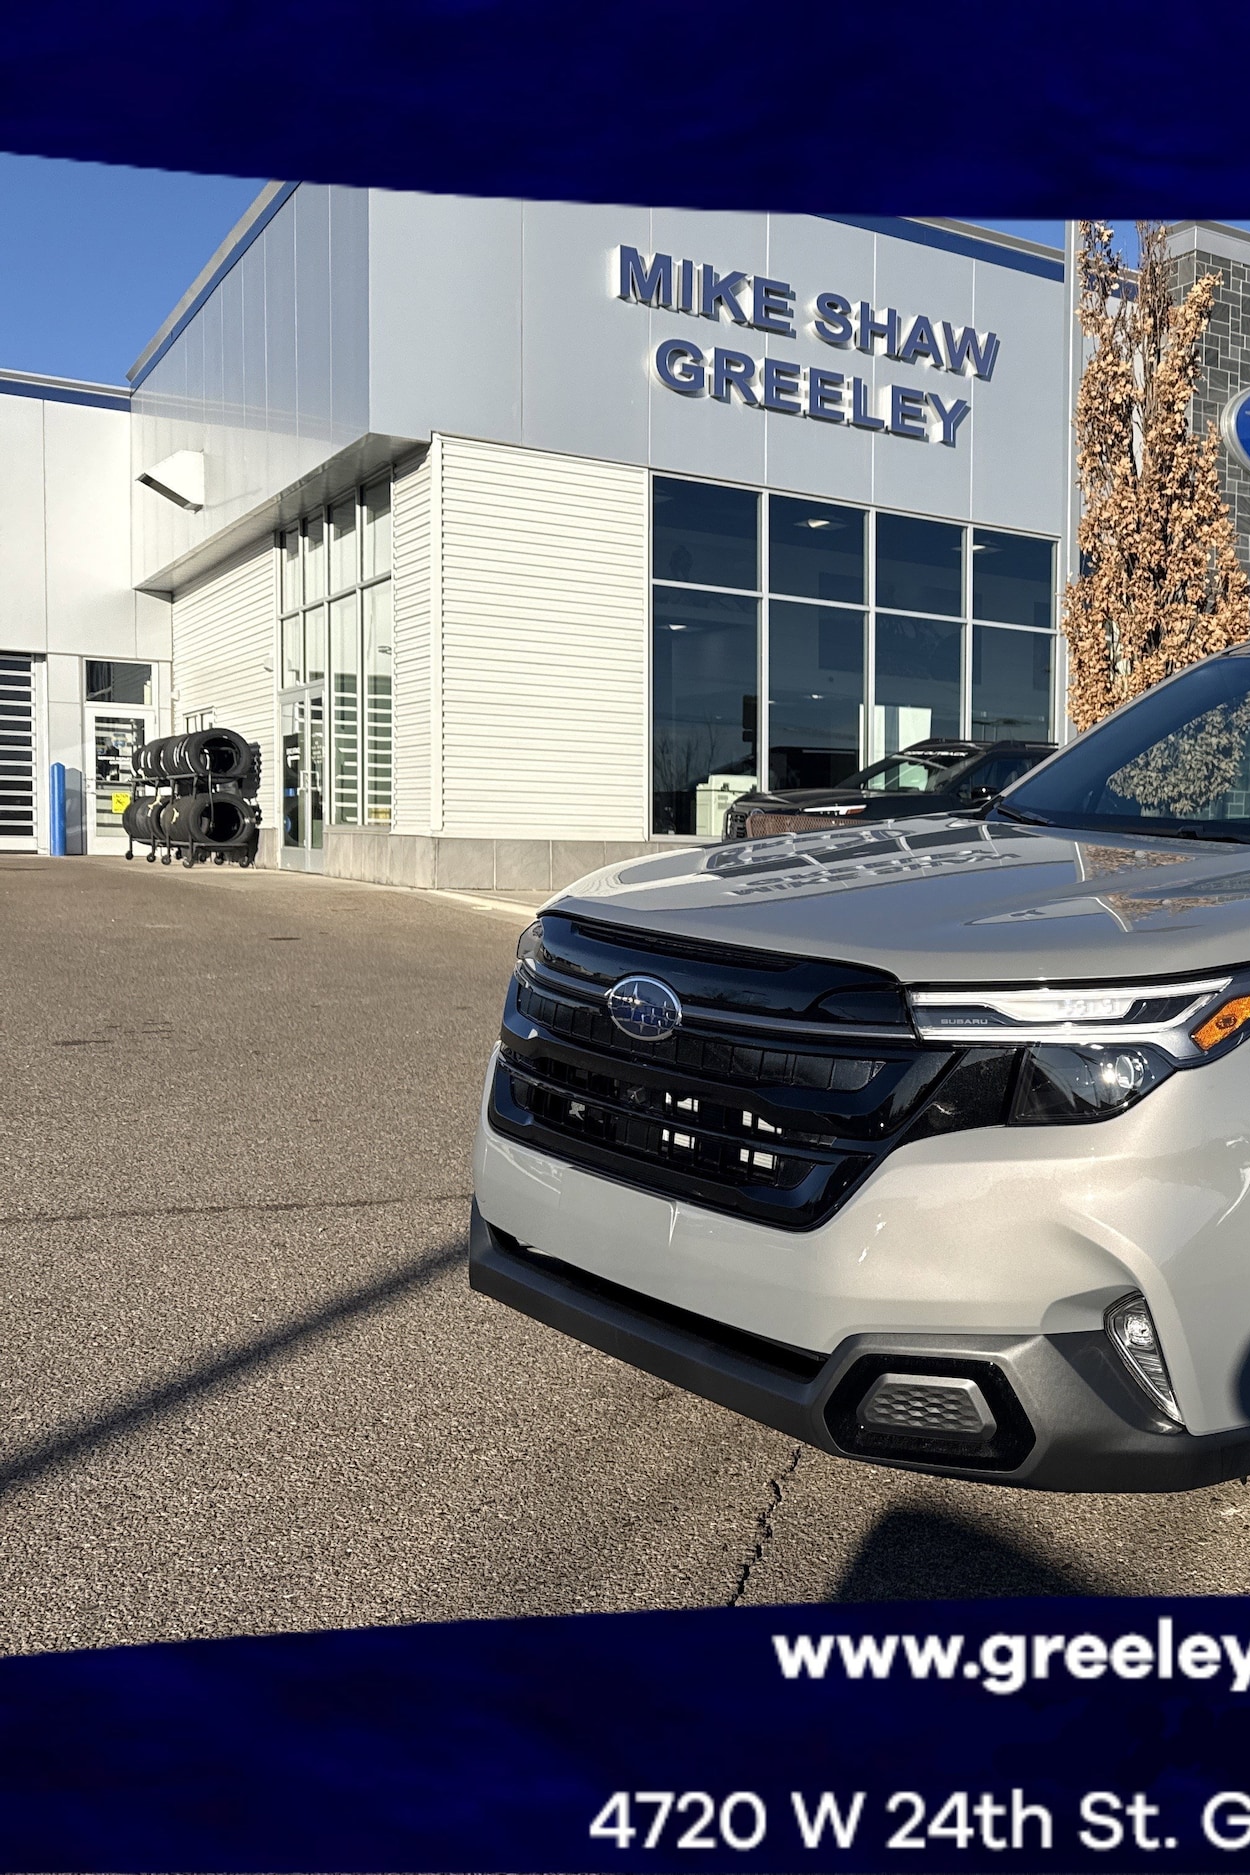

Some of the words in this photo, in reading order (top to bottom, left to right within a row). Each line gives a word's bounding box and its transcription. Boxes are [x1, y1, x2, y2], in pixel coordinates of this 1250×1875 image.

[616, 244, 796, 338] MIKE
[814, 292, 1000, 381] SHAW
[653, 338, 971, 447] GREELEY
